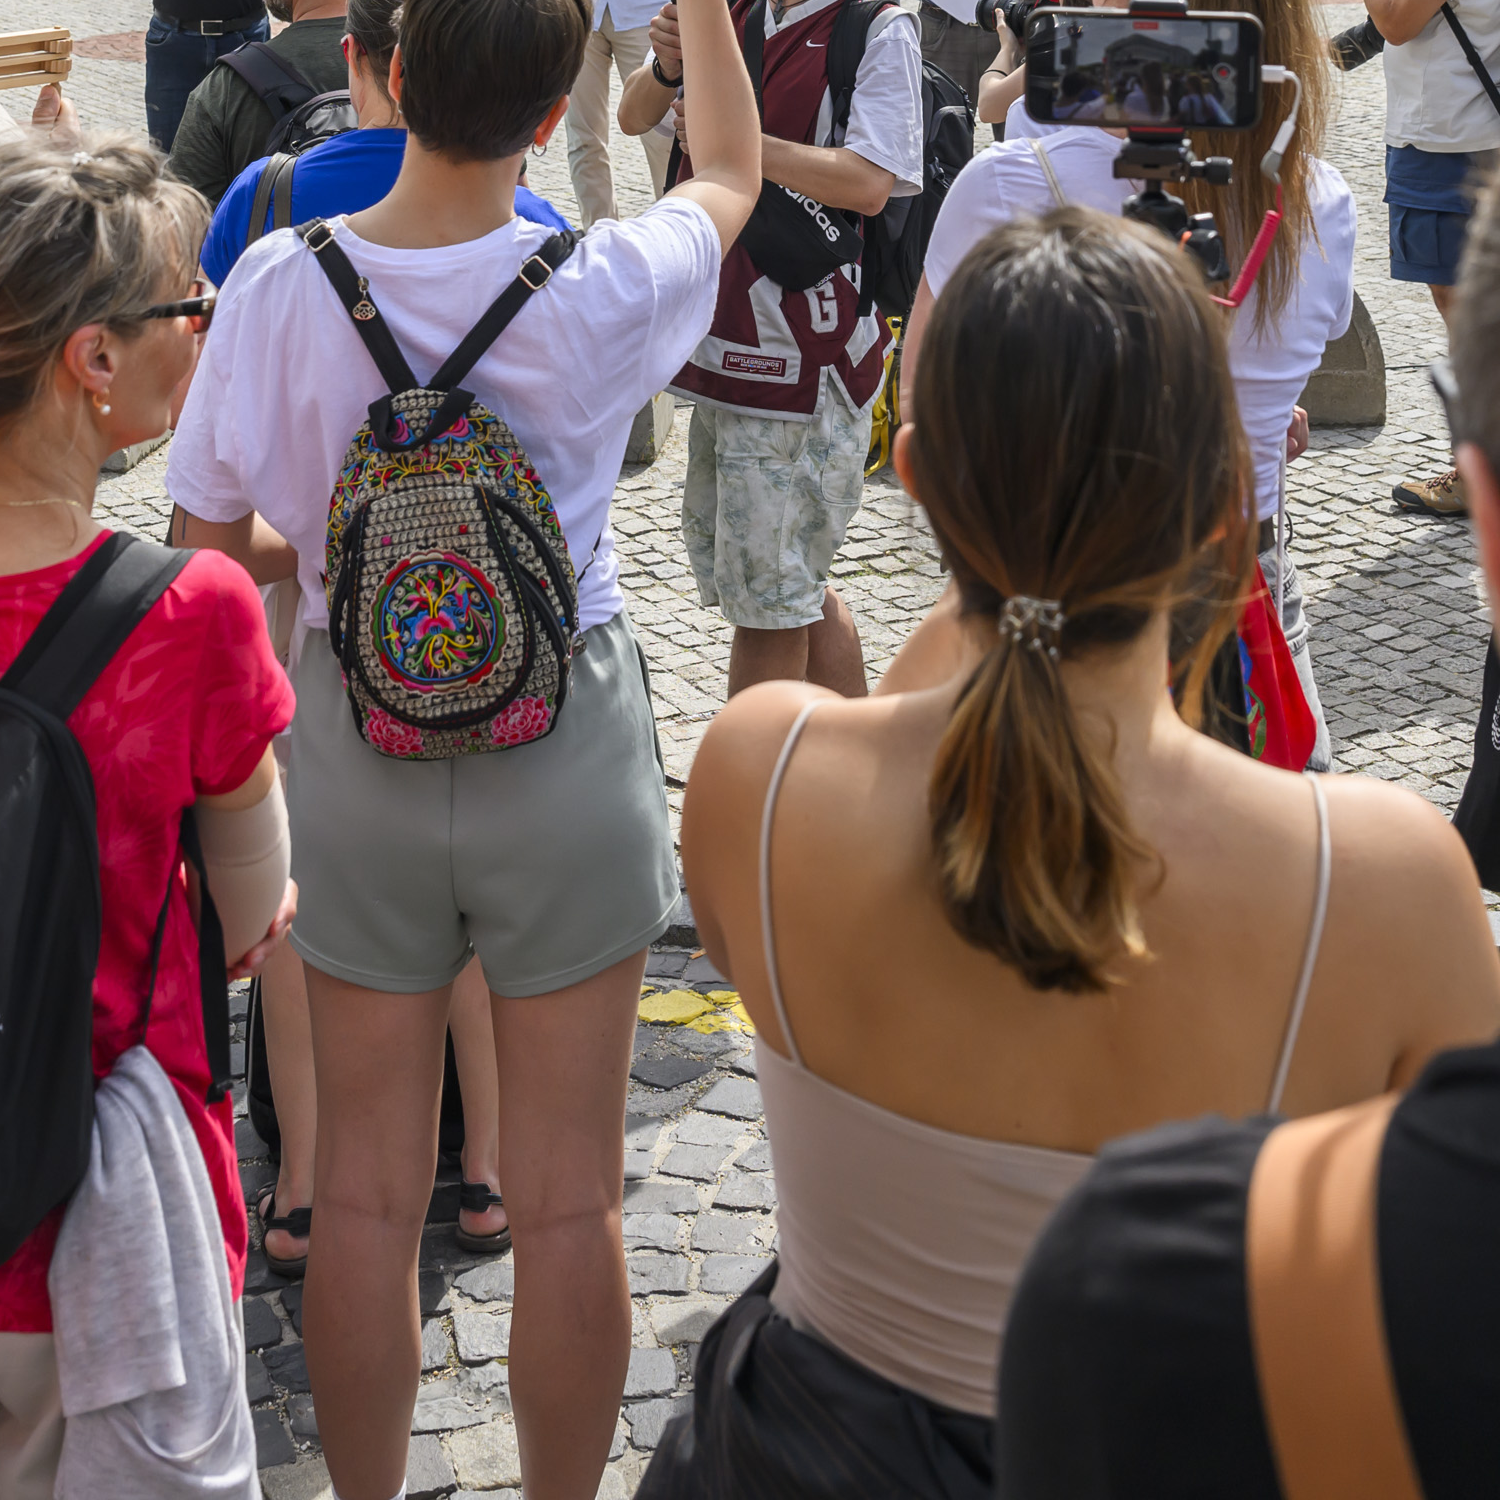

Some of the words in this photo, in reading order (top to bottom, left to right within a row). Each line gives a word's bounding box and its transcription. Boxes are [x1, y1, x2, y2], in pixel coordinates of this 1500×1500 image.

[778, 184, 841, 242] idas
[803, 280, 839, 334] G
[729, 356, 780, 368] BATTLEGROUNDS
